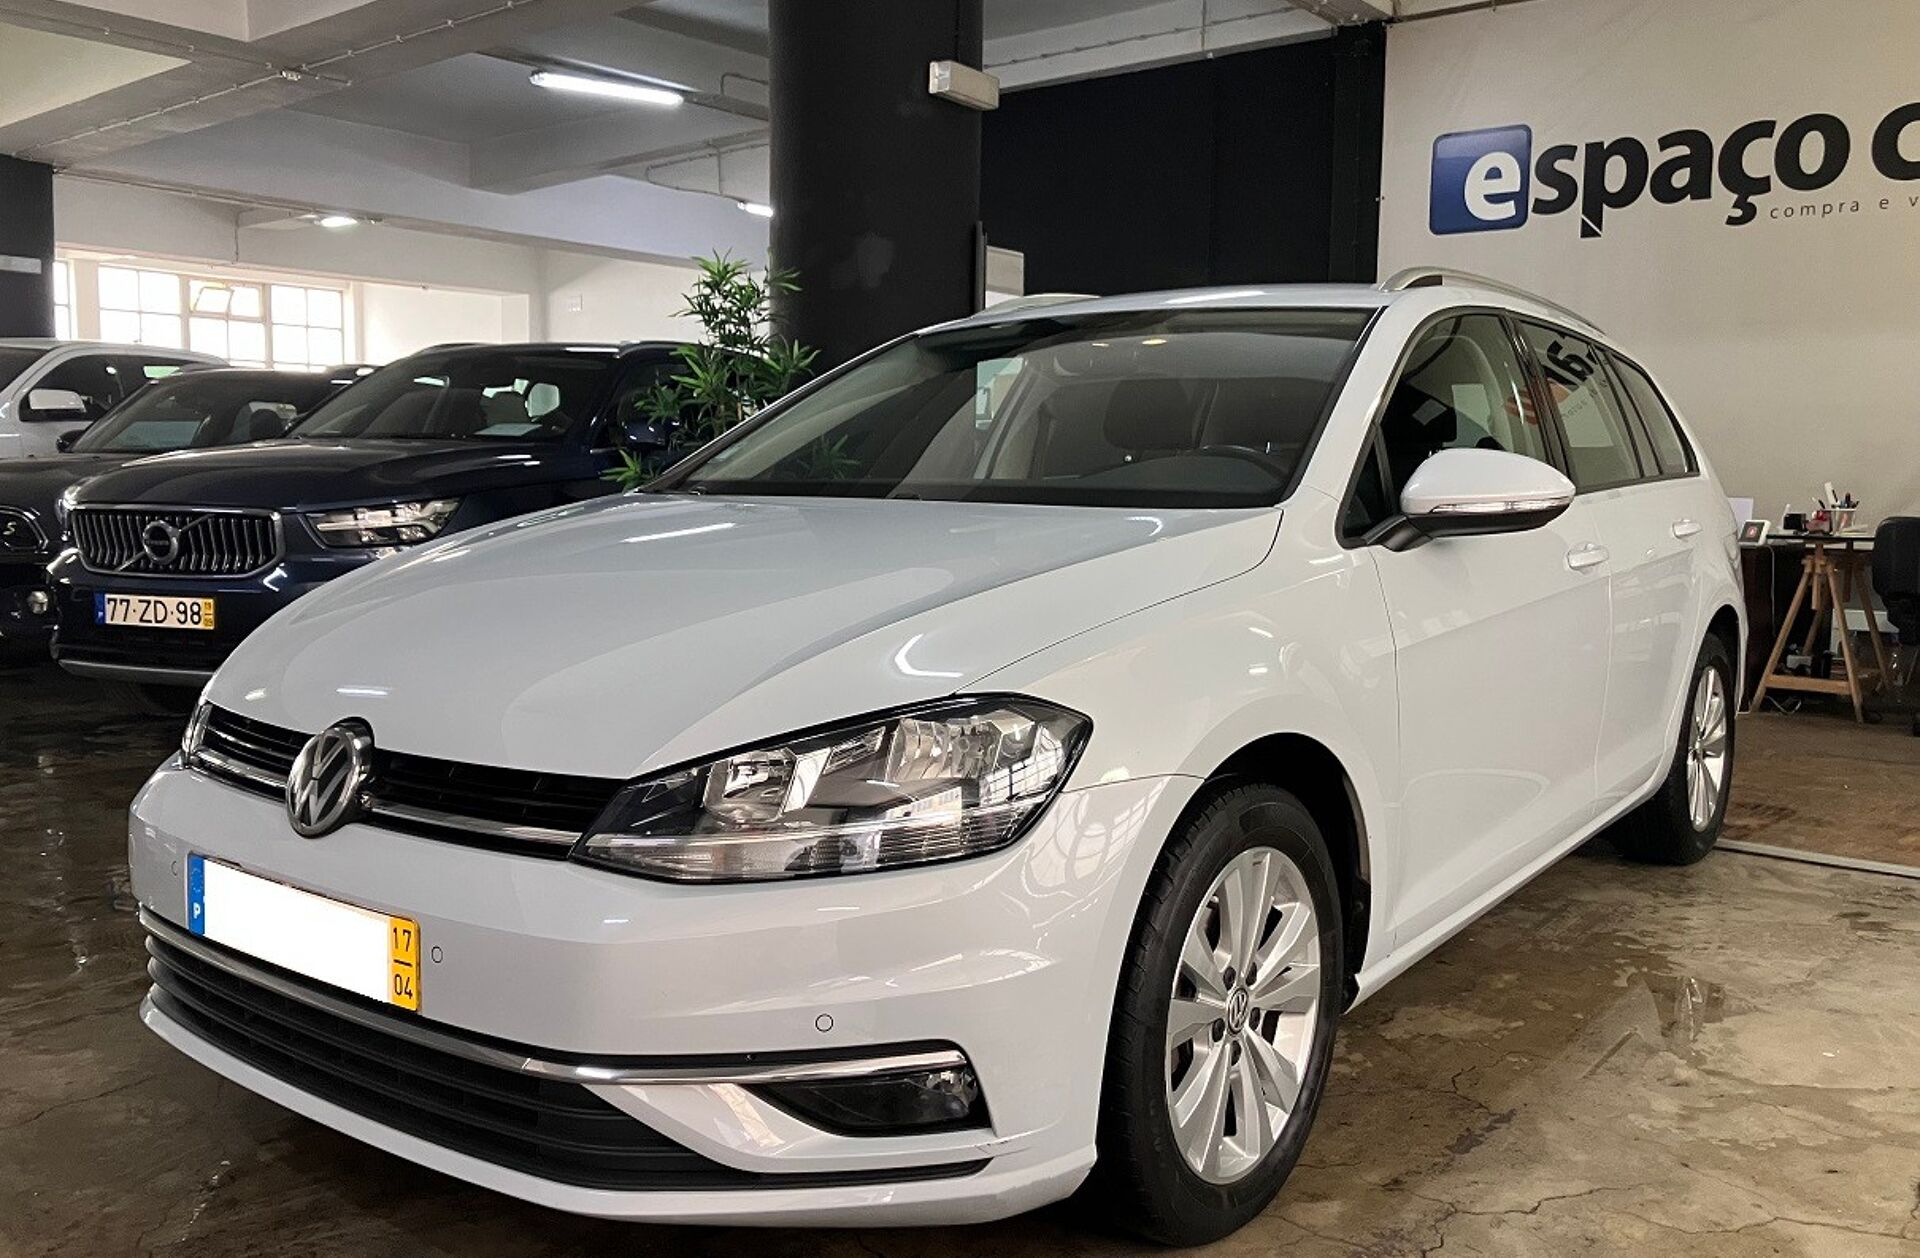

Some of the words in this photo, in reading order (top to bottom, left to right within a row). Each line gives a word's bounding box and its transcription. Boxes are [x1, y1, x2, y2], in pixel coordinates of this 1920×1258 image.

[1464, 112, 1852, 239] espaço
[1769, 200, 1860, 219] compra
[1878, 198, 1889, 210] e
[392, 927, 412, 953] 17
[394, 974, 413, 1000] 04
